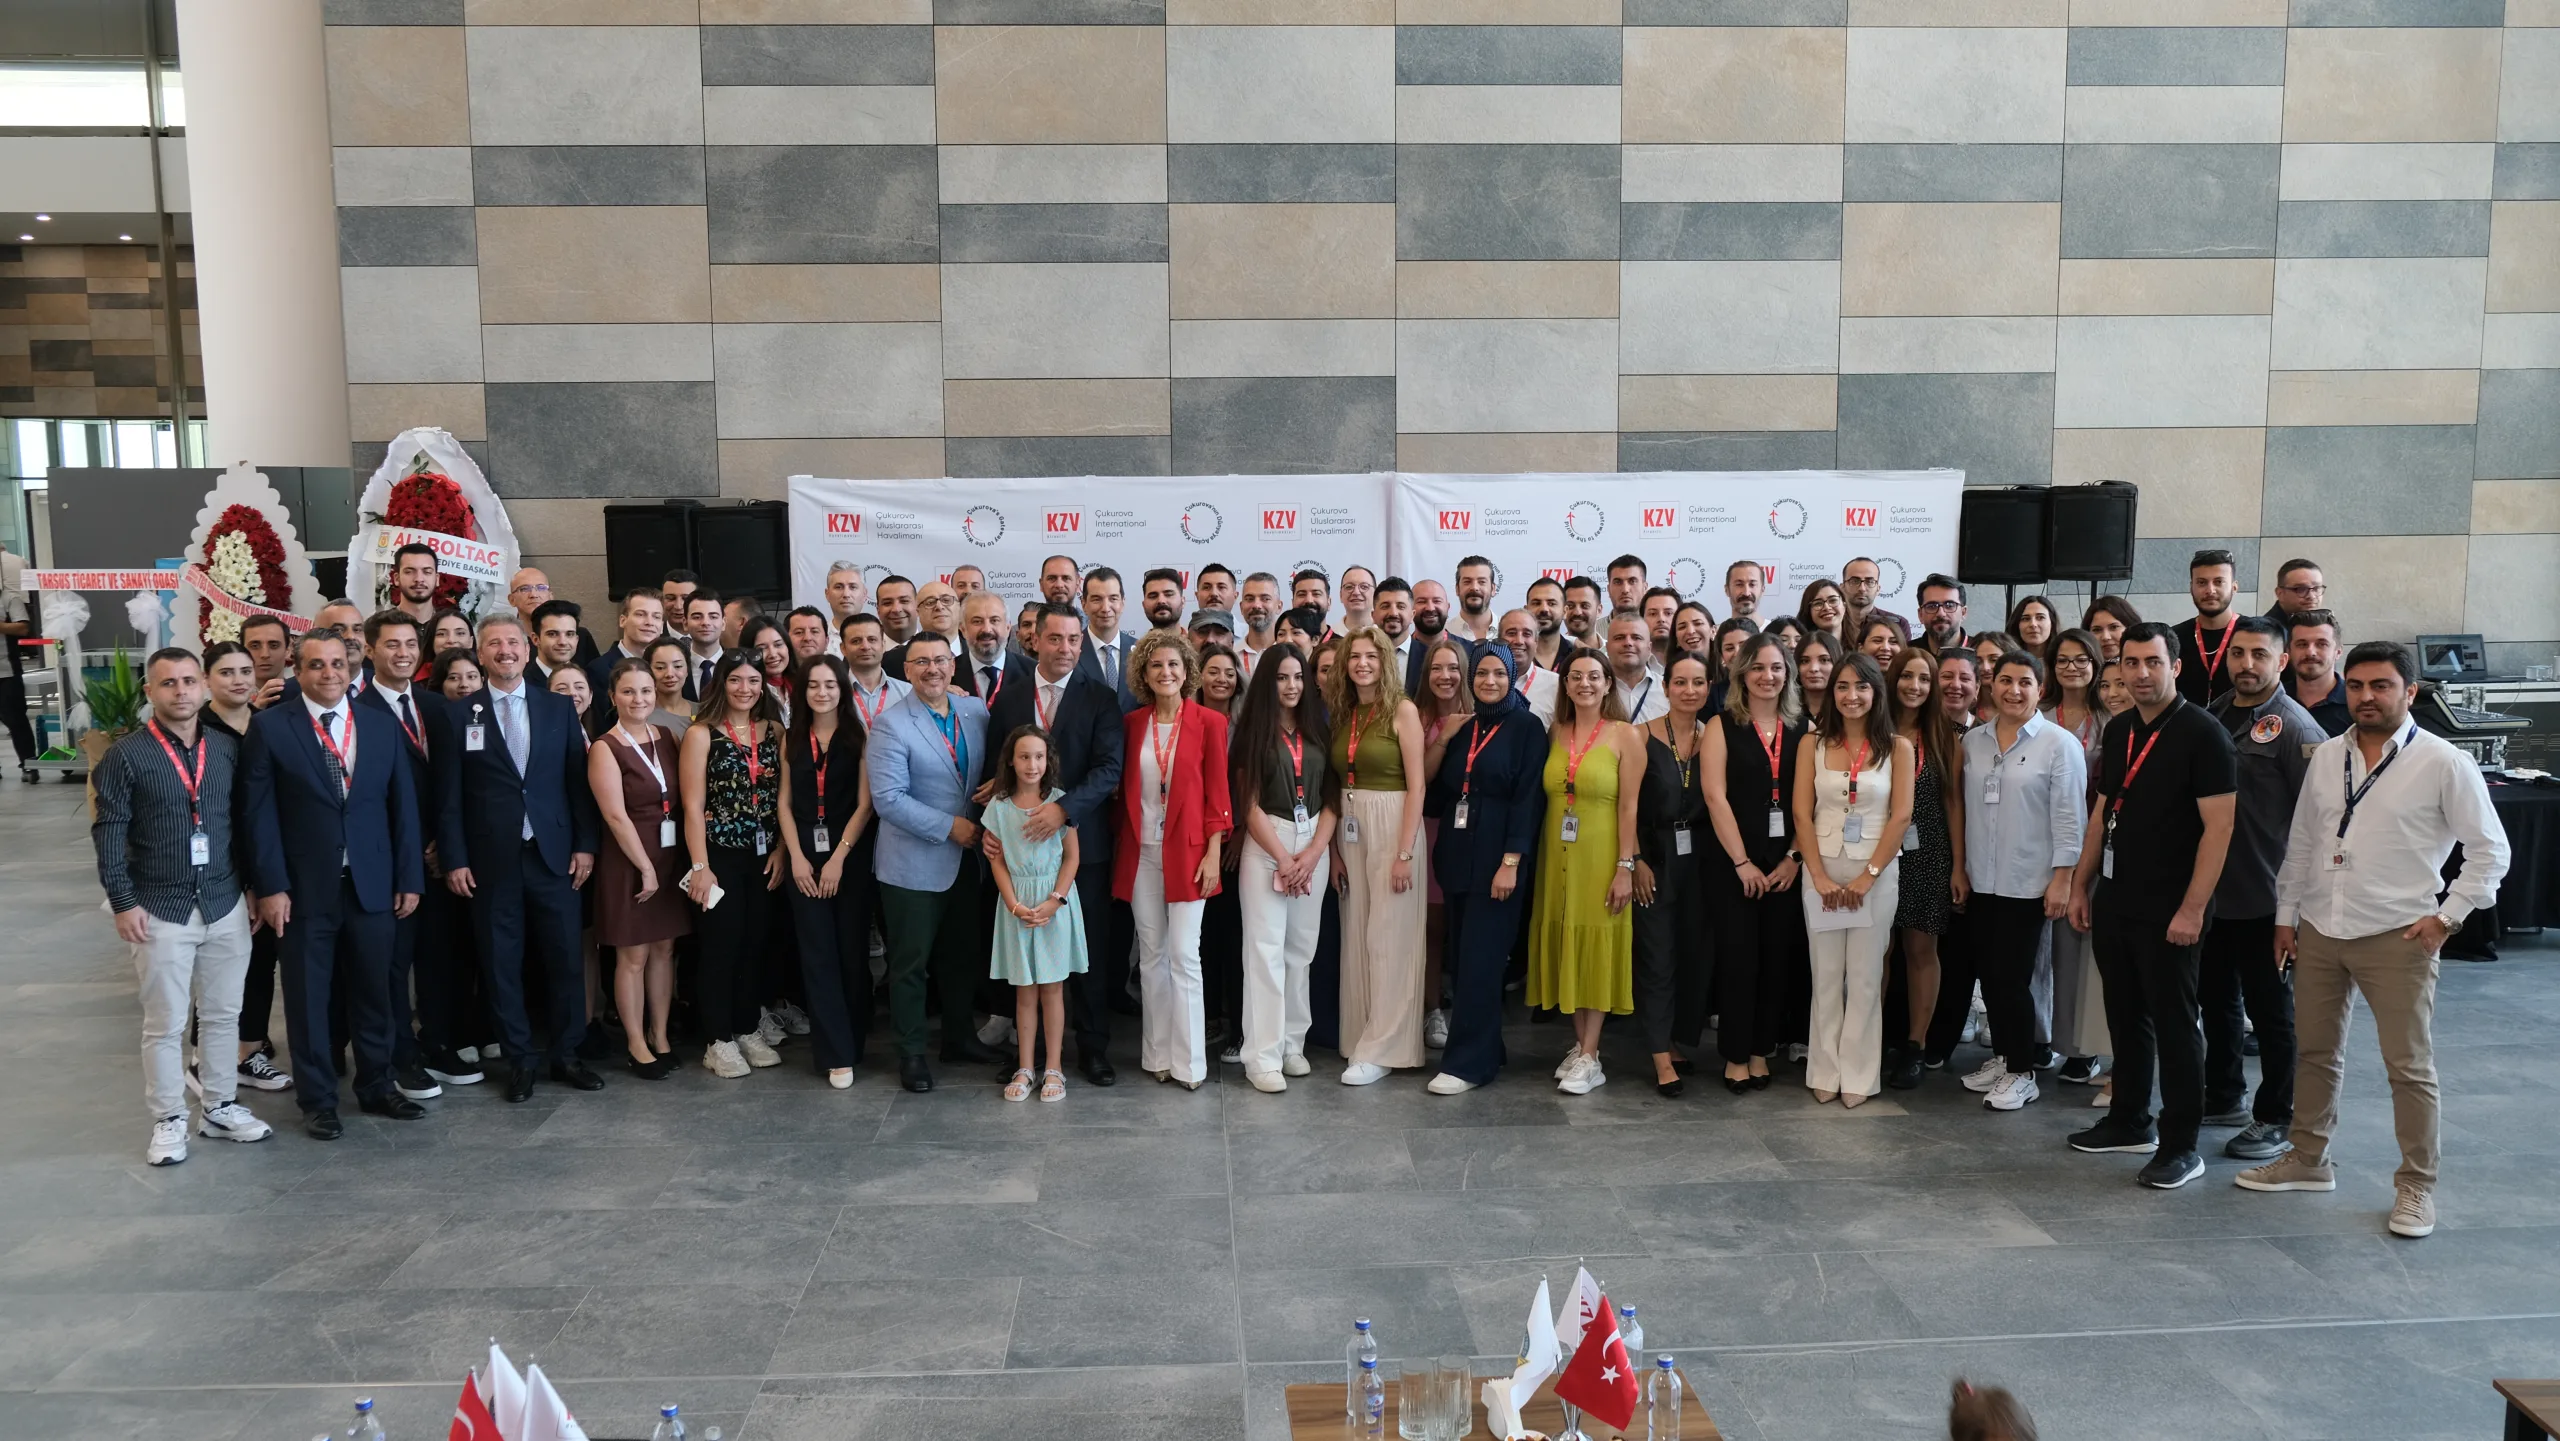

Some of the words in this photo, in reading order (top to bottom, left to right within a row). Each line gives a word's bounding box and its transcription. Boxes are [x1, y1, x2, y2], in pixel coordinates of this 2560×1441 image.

[1095, 509, 1134, 518] Çukurova
[1311, 507, 1348, 516] Çukurova
[1484, 508, 1521, 517] Çukurova
[1688, 506, 1725, 514] Çukurova
[1890, 506, 1926, 514] Çukurova
[876, 511, 915, 520] Çukurova
[1263, 510, 1296, 529] KZV
[1643, 508, 1675, 527] KZV
[1845, 507, 1877, 527] KZV
[828, 513, 861, 533] KZV
[1046, 512, 1080, 532] KZV
[1439, 511, 1471, 530] KZV
[1484, 518, 1529, 526] Uluslararası
[427, 537, 500, 568] BOLTAÇ
[438, 558, 461, 570] EDİYE
[463, 563, 499, 577] BAŞKANI
[1789, 563, 1825, 571] Çukurova
[988, 570, 1027, 579] Çukurova
[36, 573, 70, 589] TARSUS
[72, 570, 106, 589] TİCARET
[107, 573, 118, 589] VE
[120, 570, 151, 589] SANAYİ
[152, 572, 179, 589] ODASI
[988, 581, 1035, 589] Uluslararası
[1788, 583, 1807, 591] Airpo
